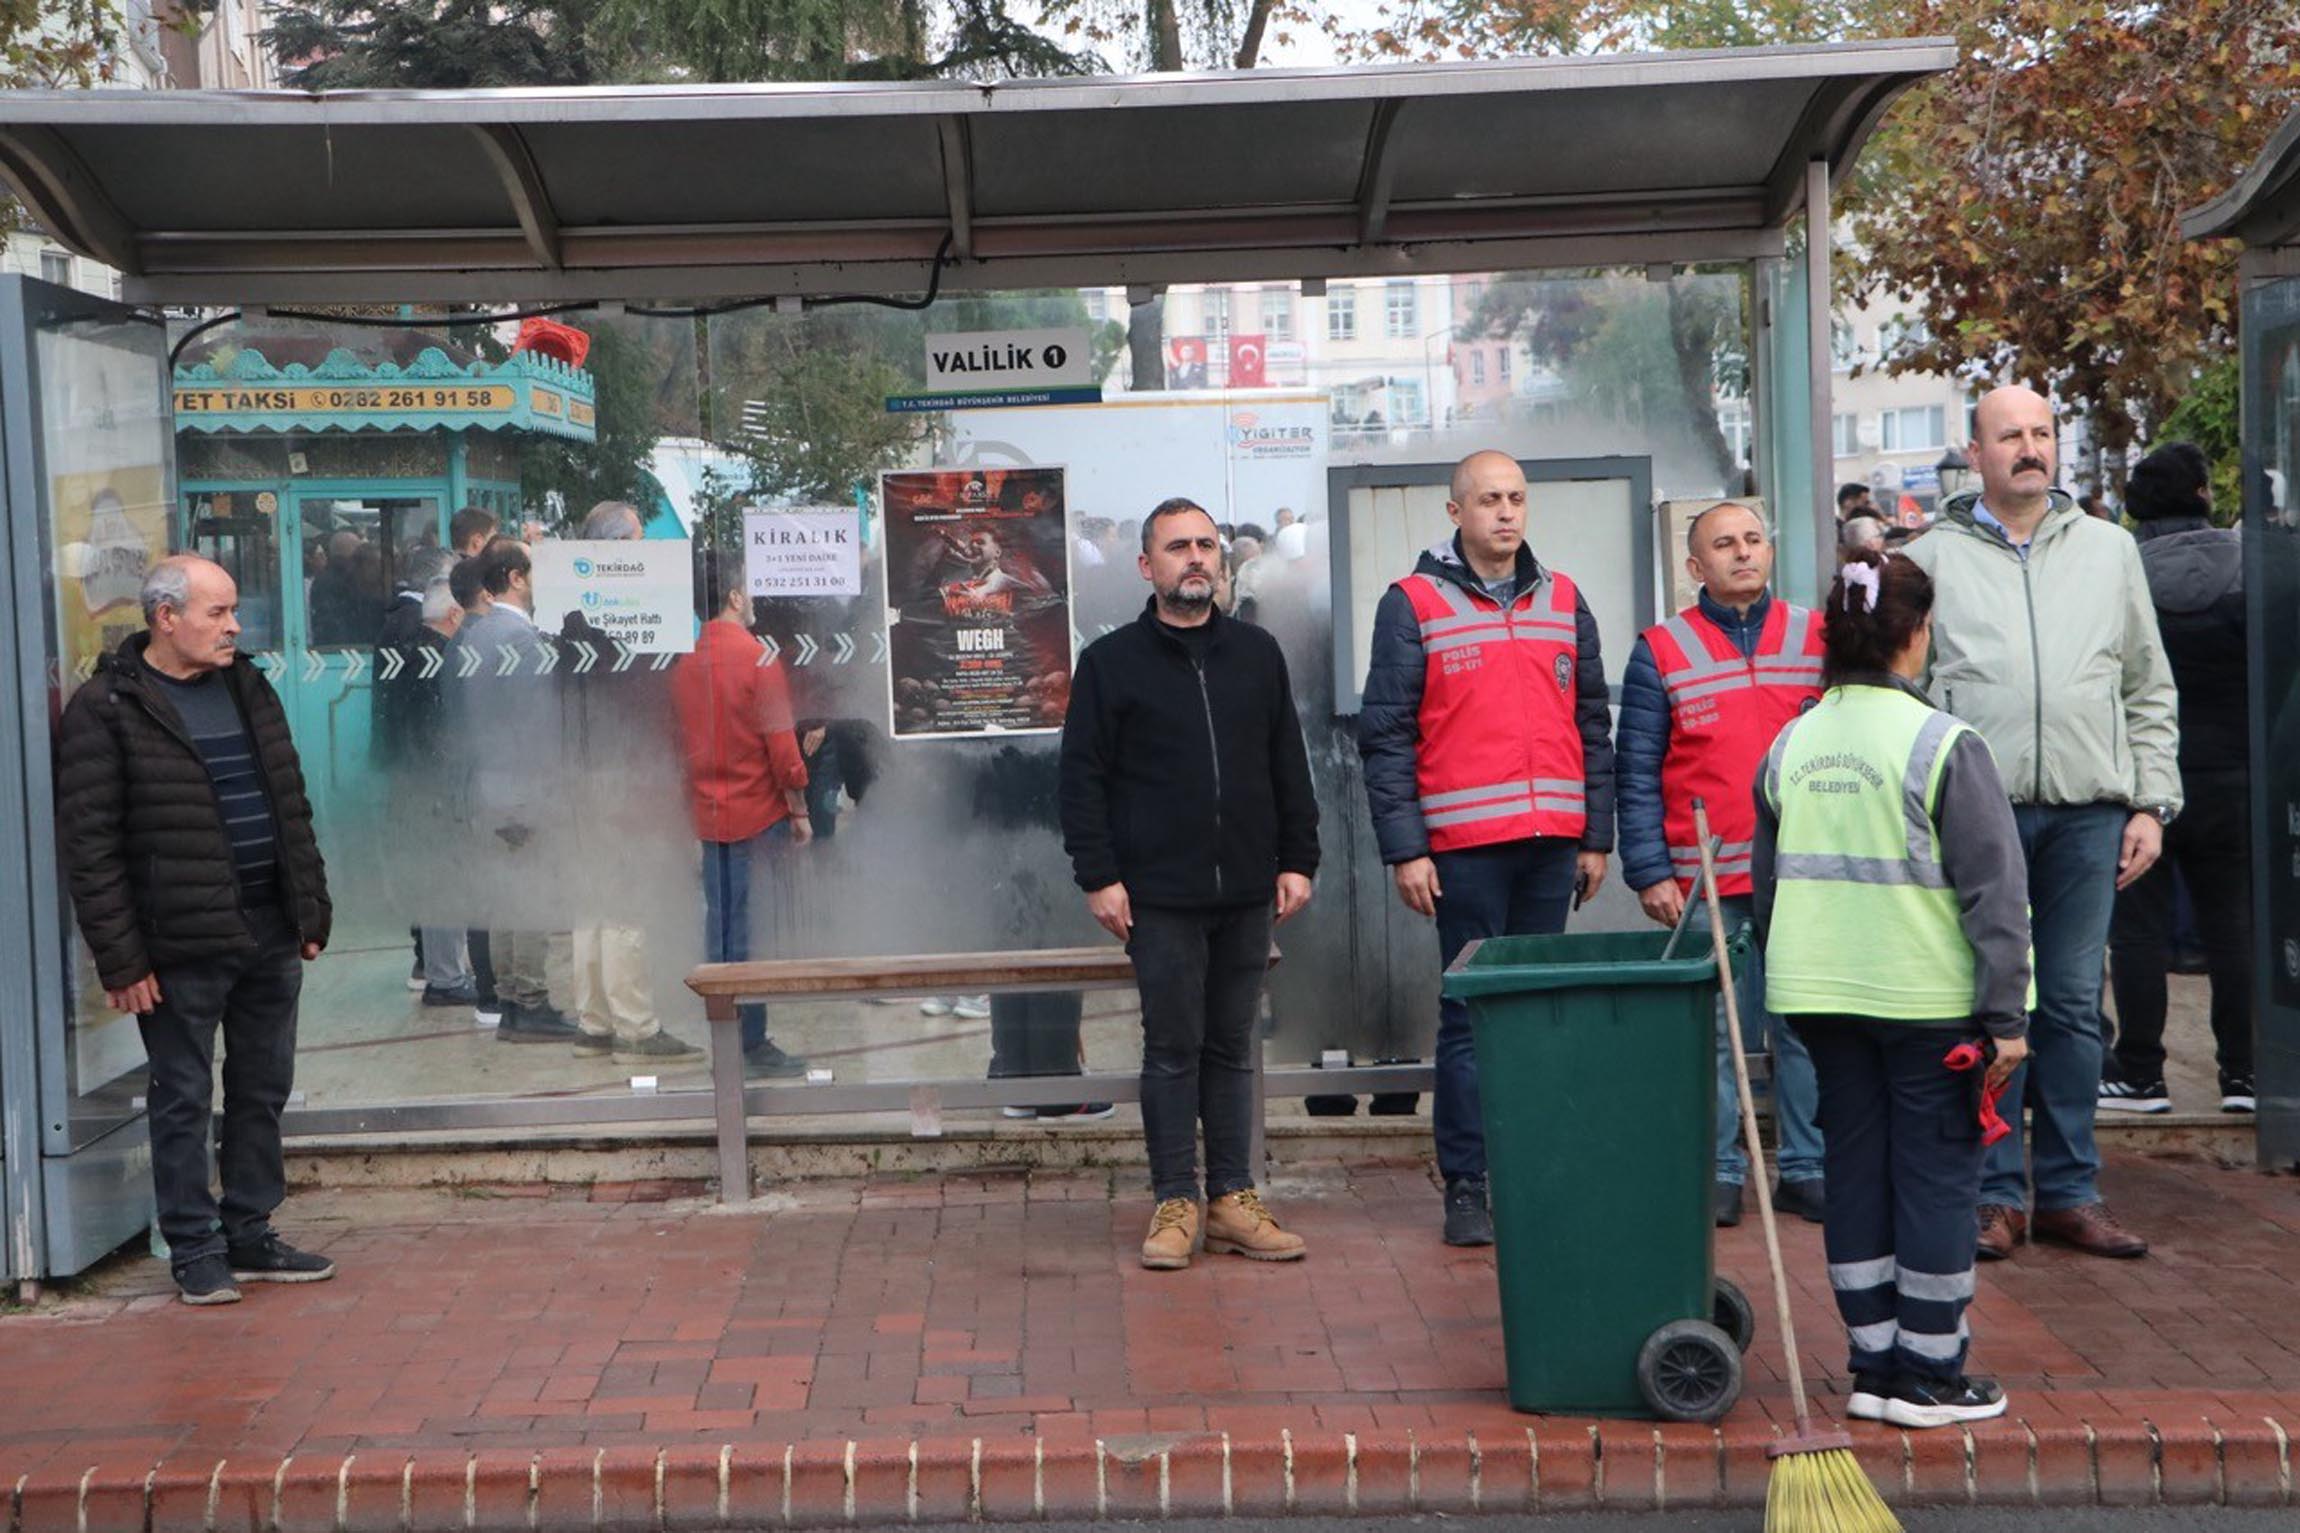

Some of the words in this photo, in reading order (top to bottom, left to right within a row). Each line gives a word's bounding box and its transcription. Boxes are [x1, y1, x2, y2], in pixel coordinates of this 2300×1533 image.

[933, 343, 1034, 373] VALİLİK
[330, 391, 381, 408] 0282
[389, 391, 426, 407] 261
[434, 391, 458, 407] 91
[466, 391, 492, 406] 58
[754, 528, 847, 545] KİRALIK
[596, 562, 645, 572] TEKİRDAĞ
[754, 578, 762, 588] 0
[603, 613, 637, 628] Şikayet
[642, 630, 655, 644] 89
[957, 628, 1004, 651] WEGH
